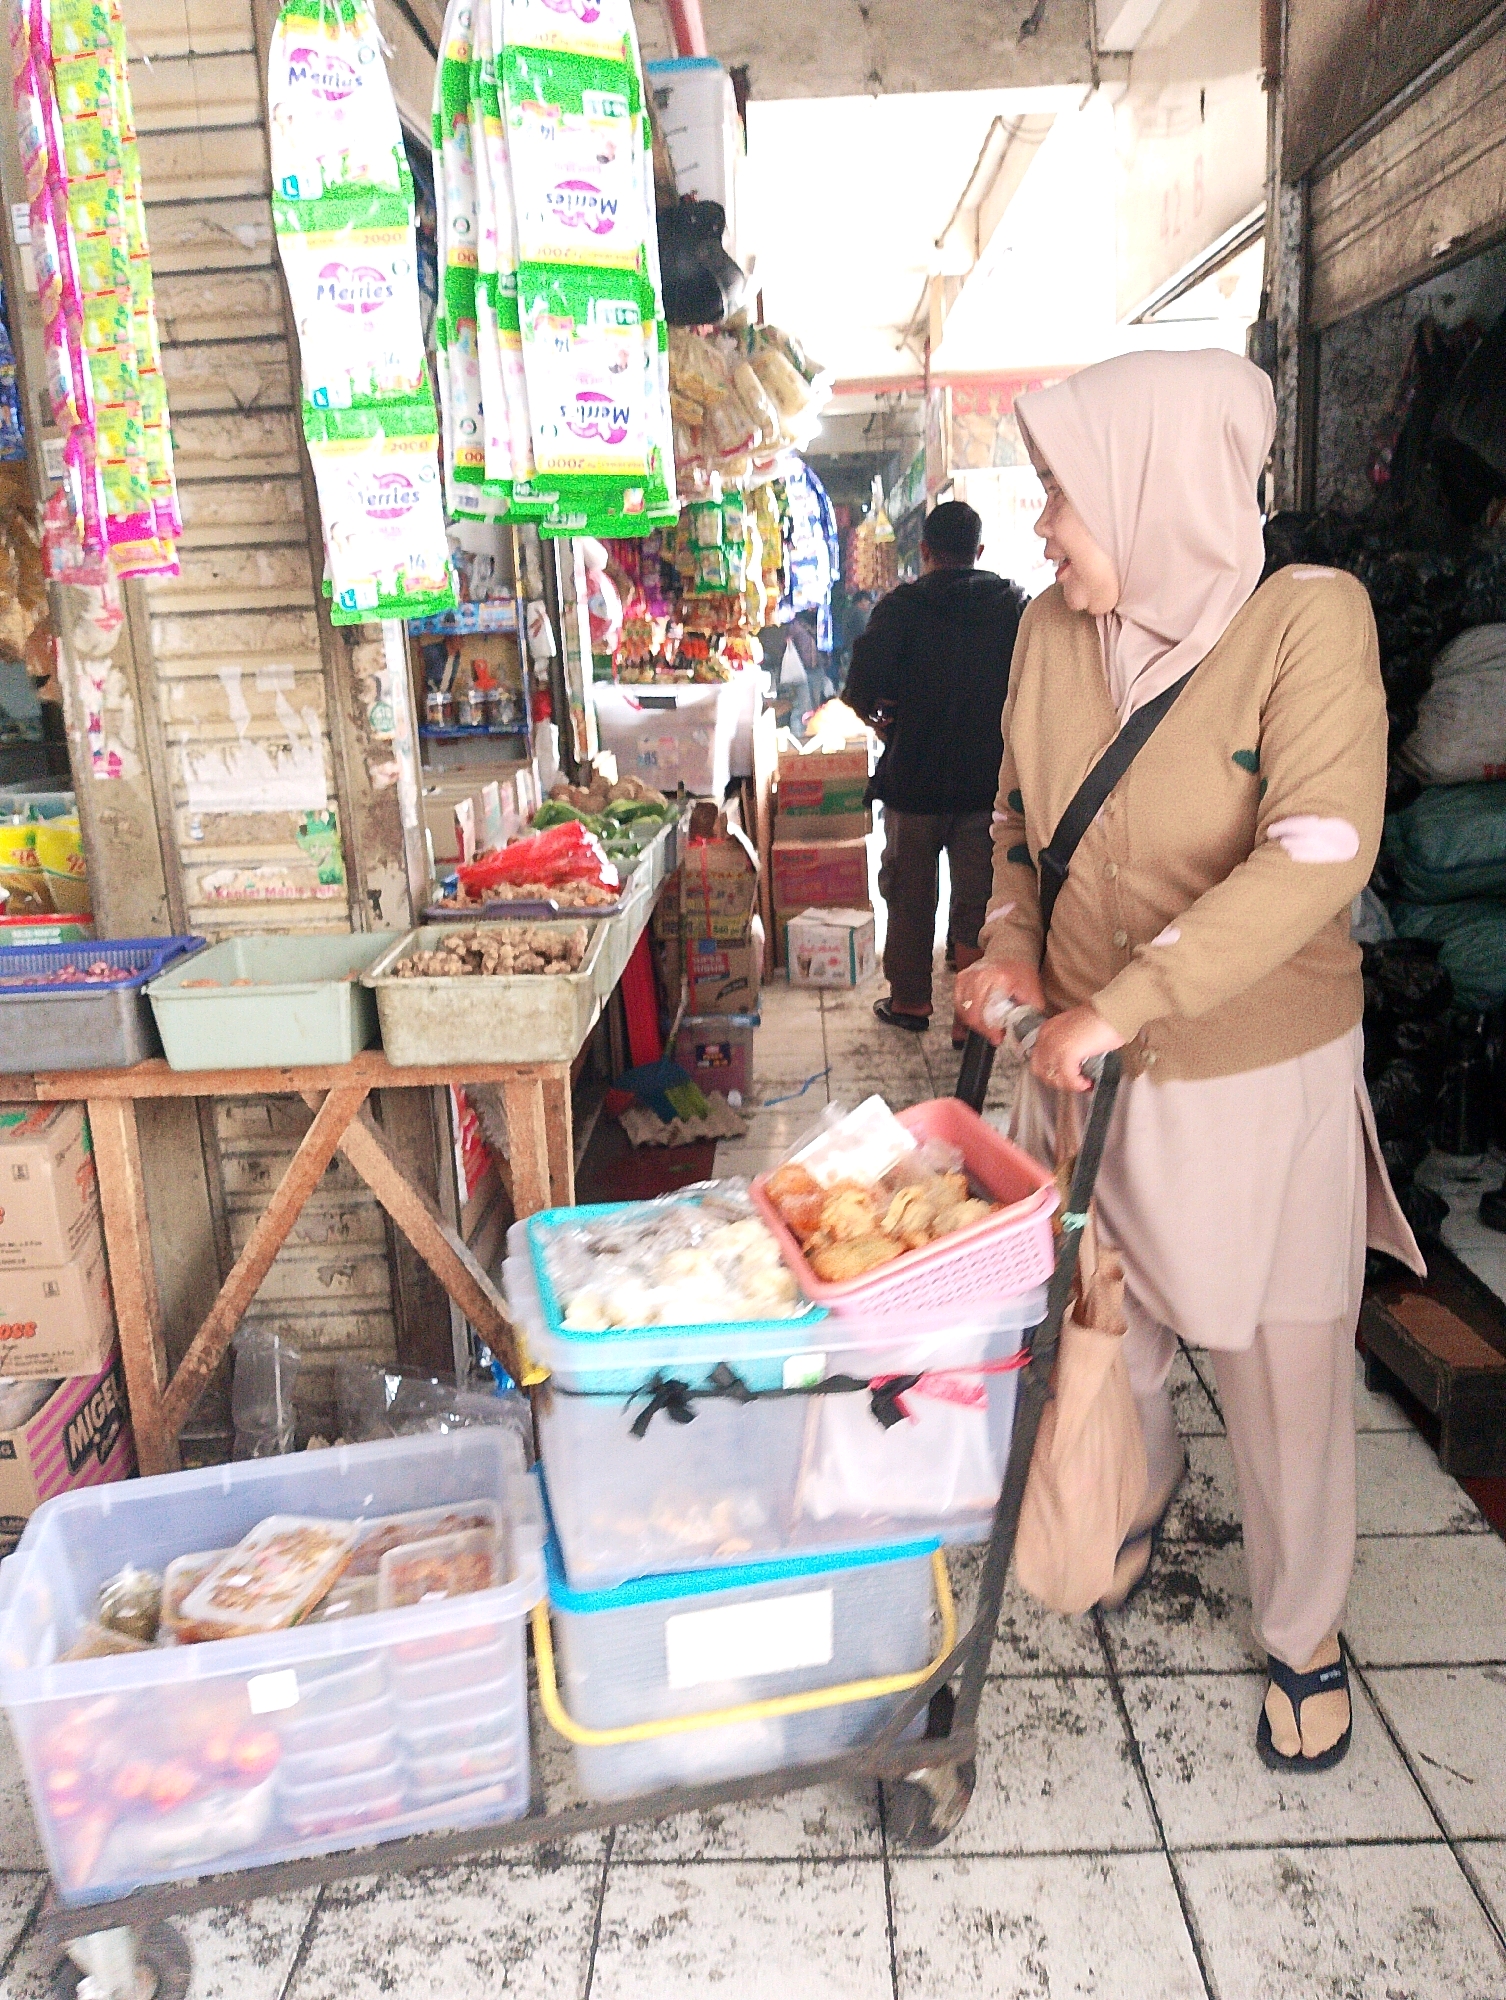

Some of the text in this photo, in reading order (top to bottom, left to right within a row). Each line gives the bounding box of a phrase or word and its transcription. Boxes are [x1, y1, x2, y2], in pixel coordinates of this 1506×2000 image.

[546, 193, 618, 216] Merries
[316, 282, 394, 301] Merries
[560, 404, 630, 425] Merris
[547, 458, 586, 469] 2000
